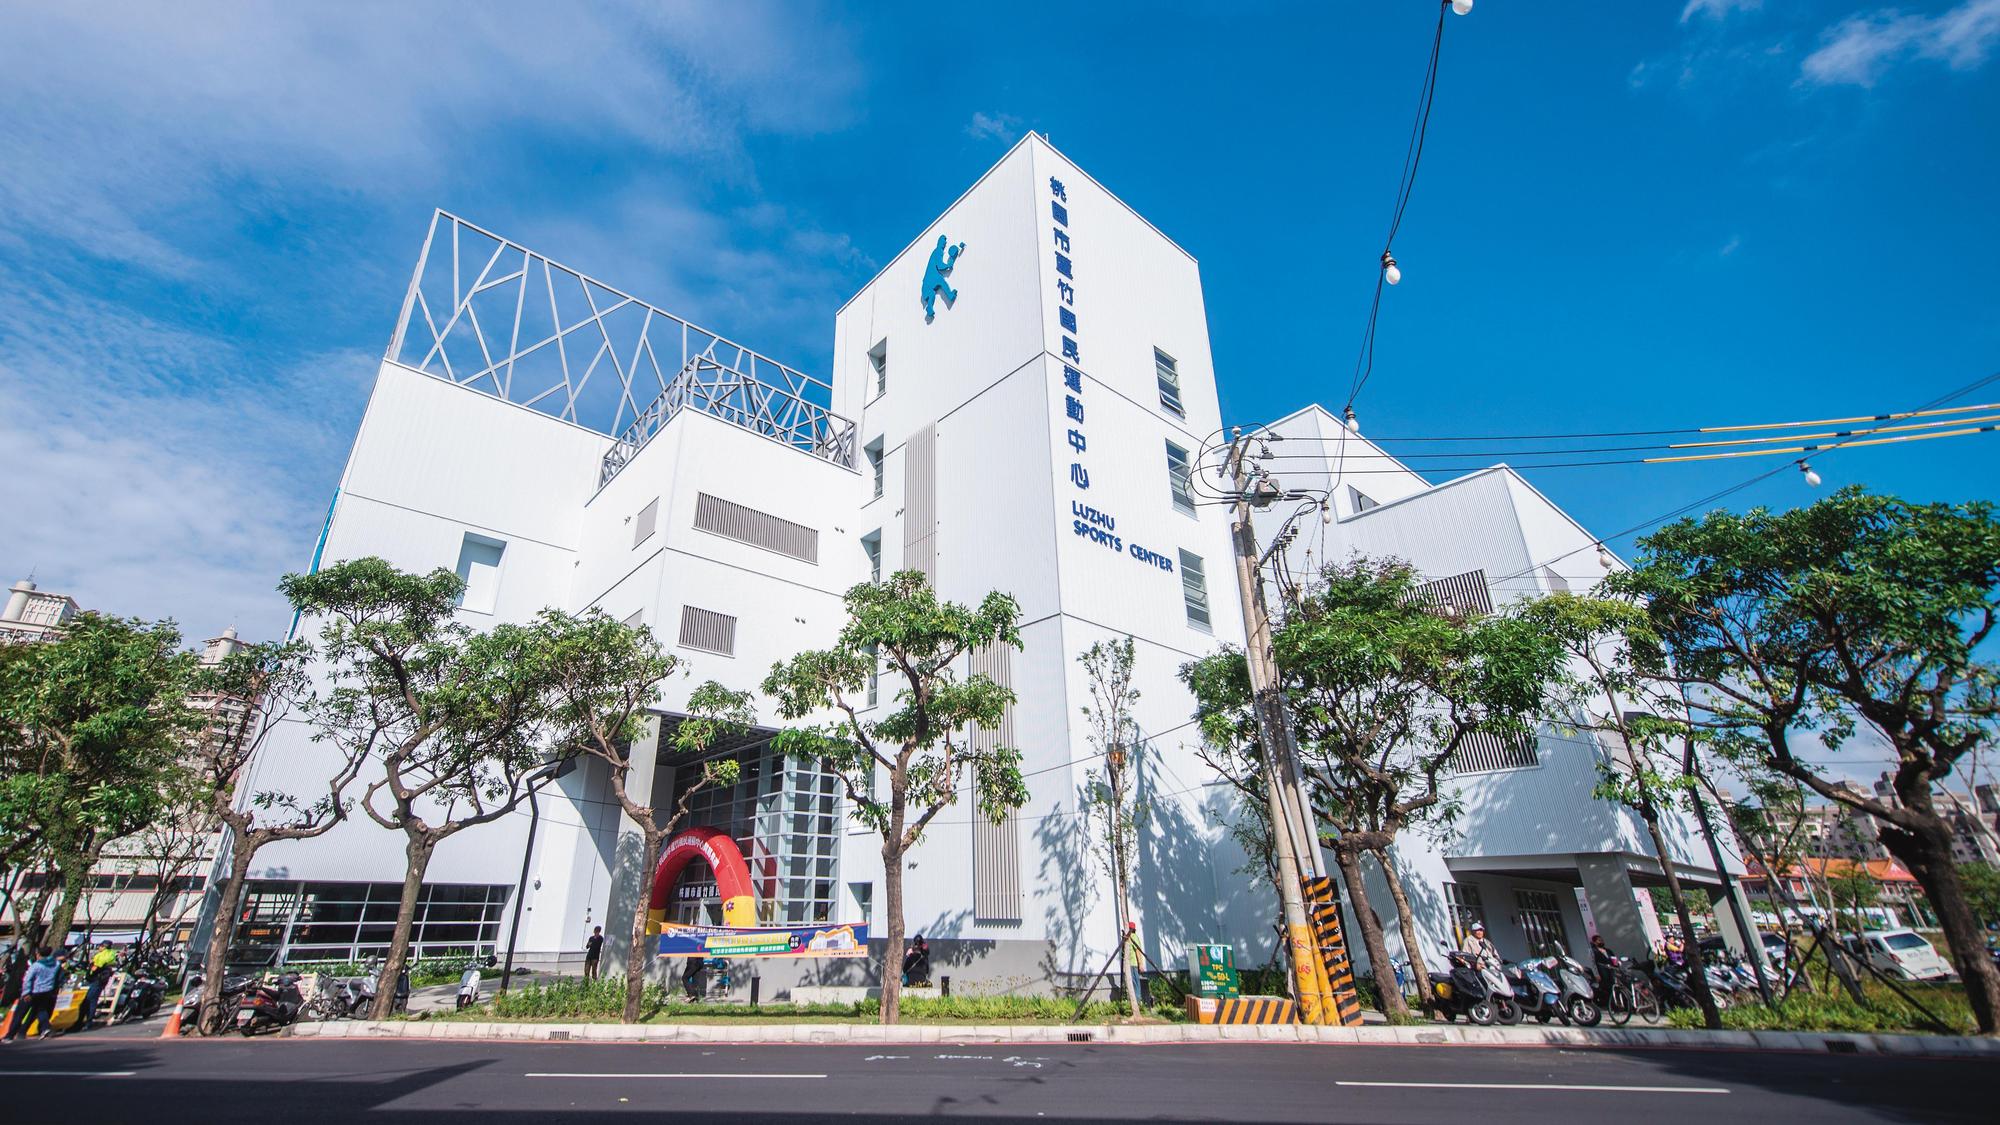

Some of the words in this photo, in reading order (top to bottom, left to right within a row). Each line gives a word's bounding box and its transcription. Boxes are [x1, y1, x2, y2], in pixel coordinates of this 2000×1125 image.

[1049, 175, 1090, 490] 桃園市蘆竹國民運動中心
[1072, 500, 1115, 531] LUZHU
[1073, 520, 1123, 553] SPORTS
[1129, 543, 1174, 573] CENTER
